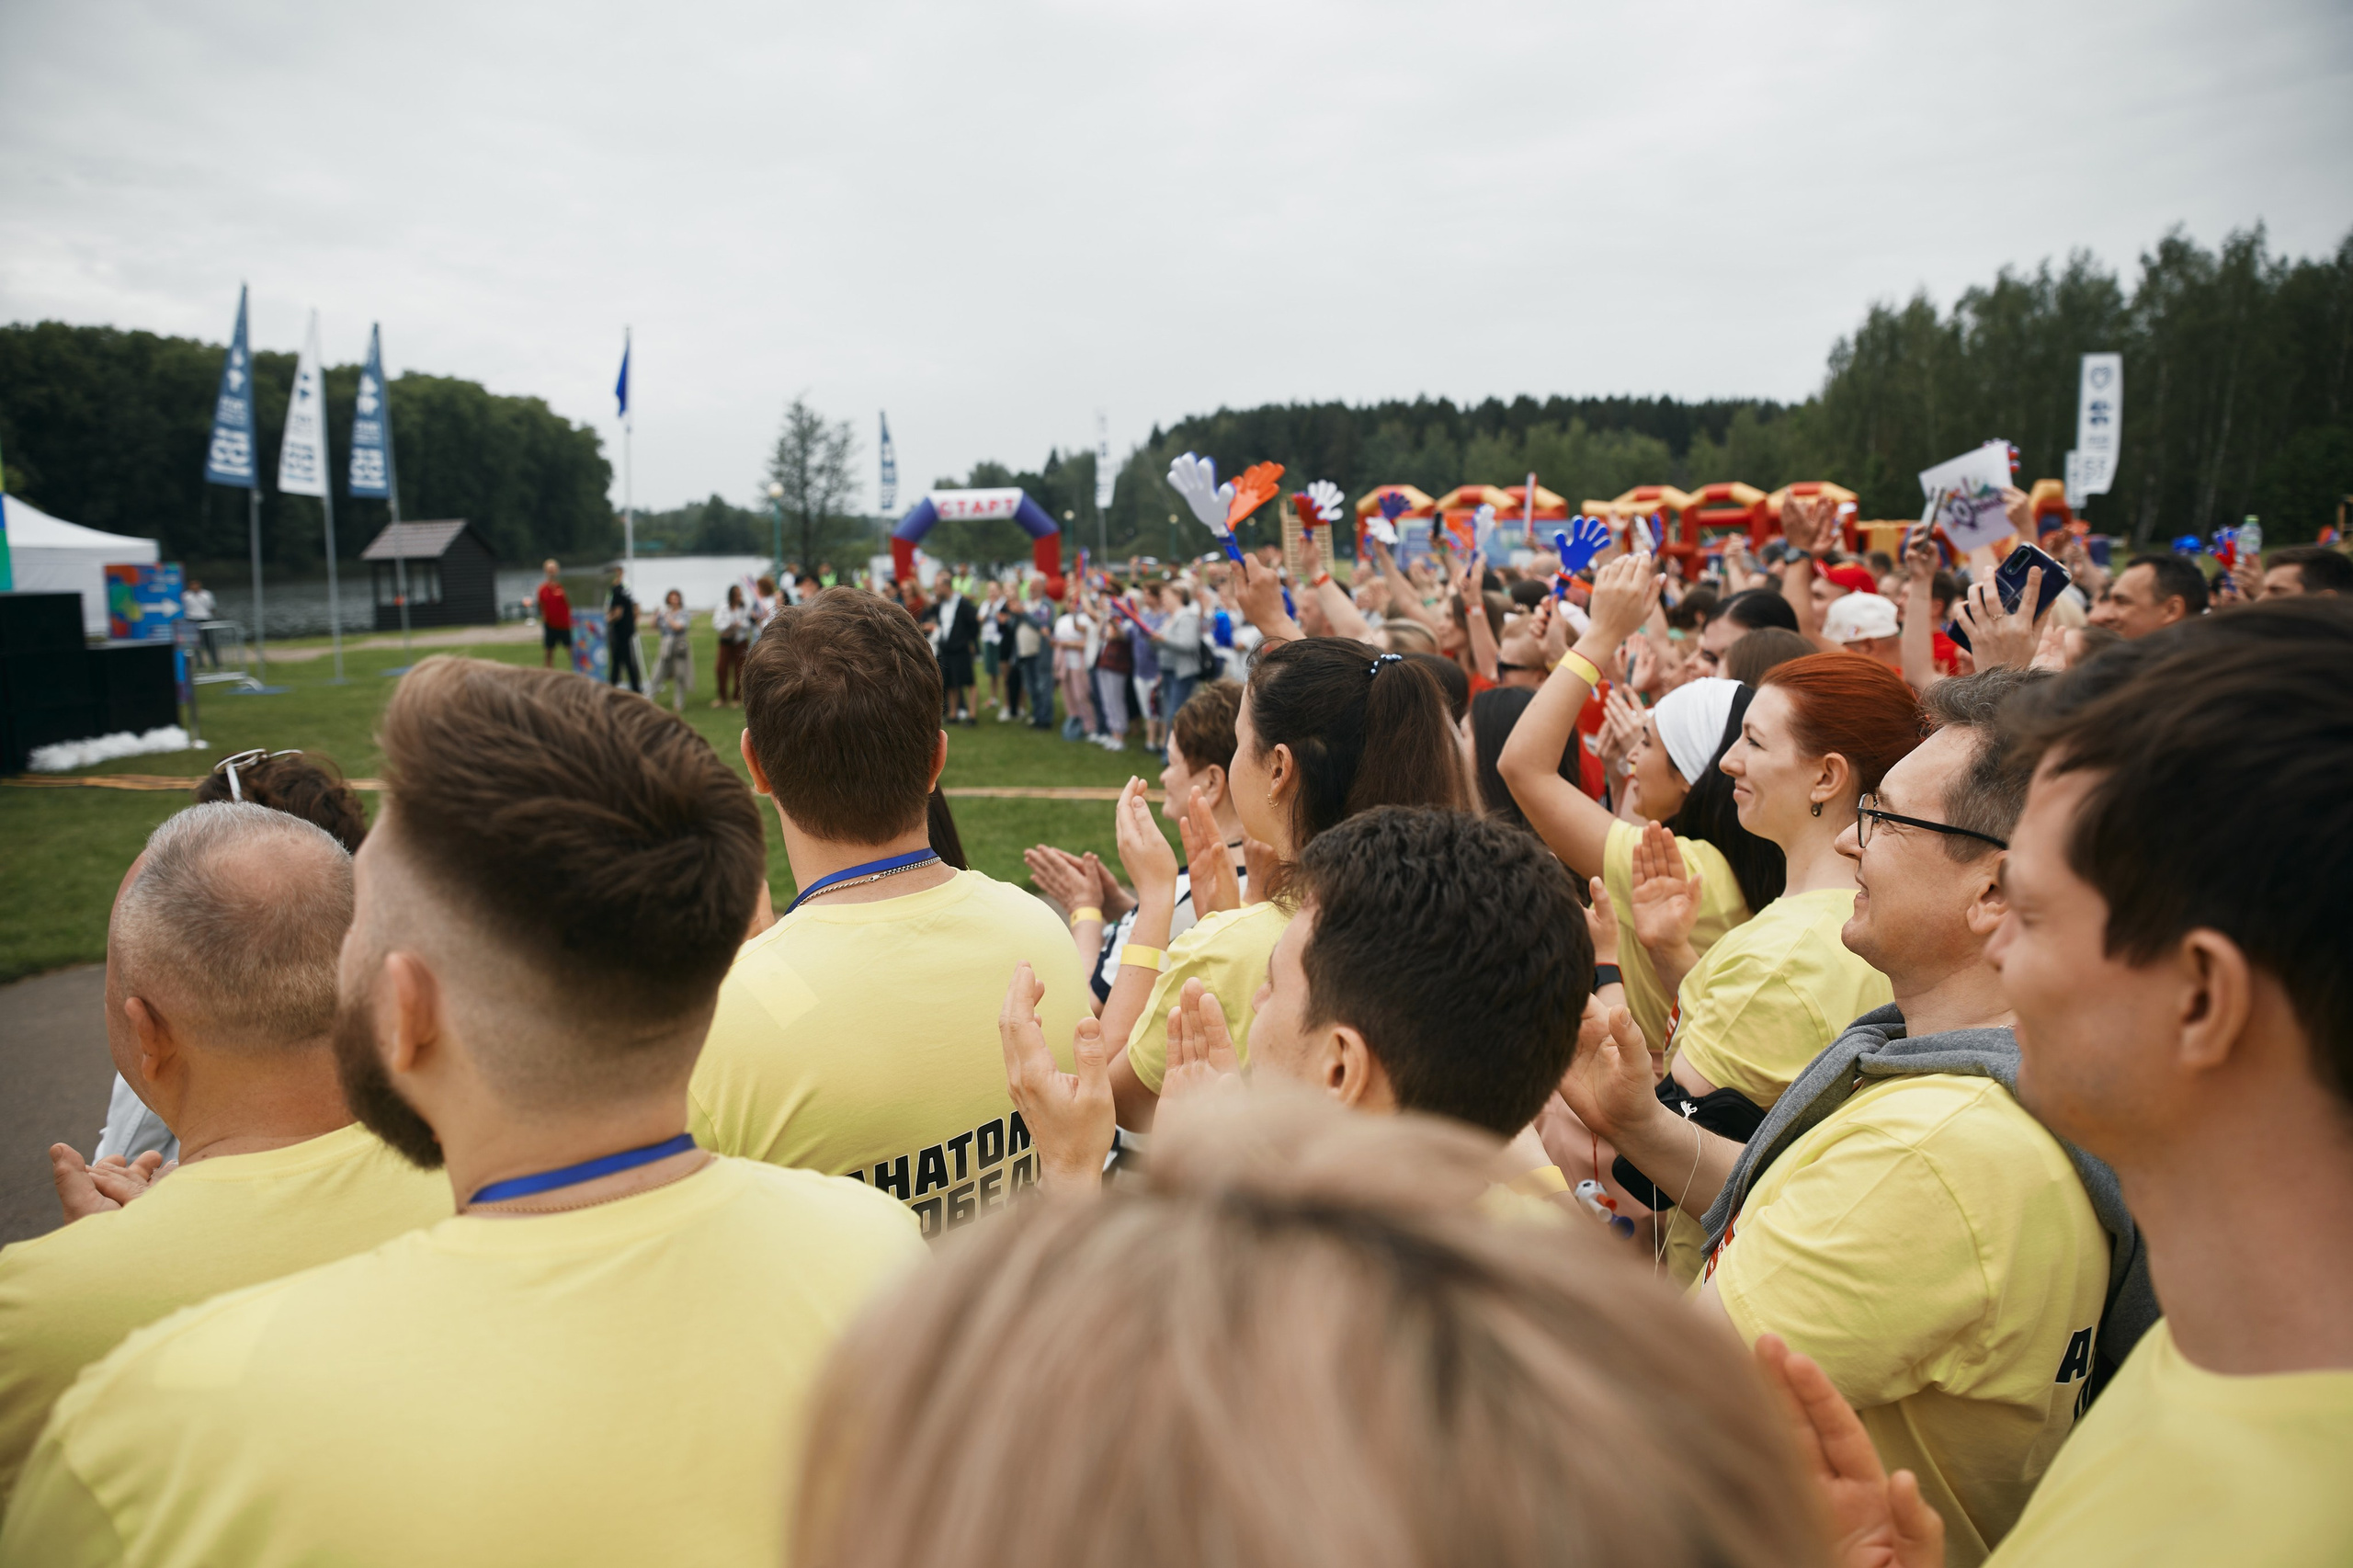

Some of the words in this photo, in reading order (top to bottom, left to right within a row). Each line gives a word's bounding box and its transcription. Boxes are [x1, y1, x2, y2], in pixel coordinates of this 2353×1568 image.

[938, 498, 1015, 517] СТАРТ
[845, 1109, 1035, 1202] НАТОМ
[909, 1151, 1042, 1241] ОБЕД
